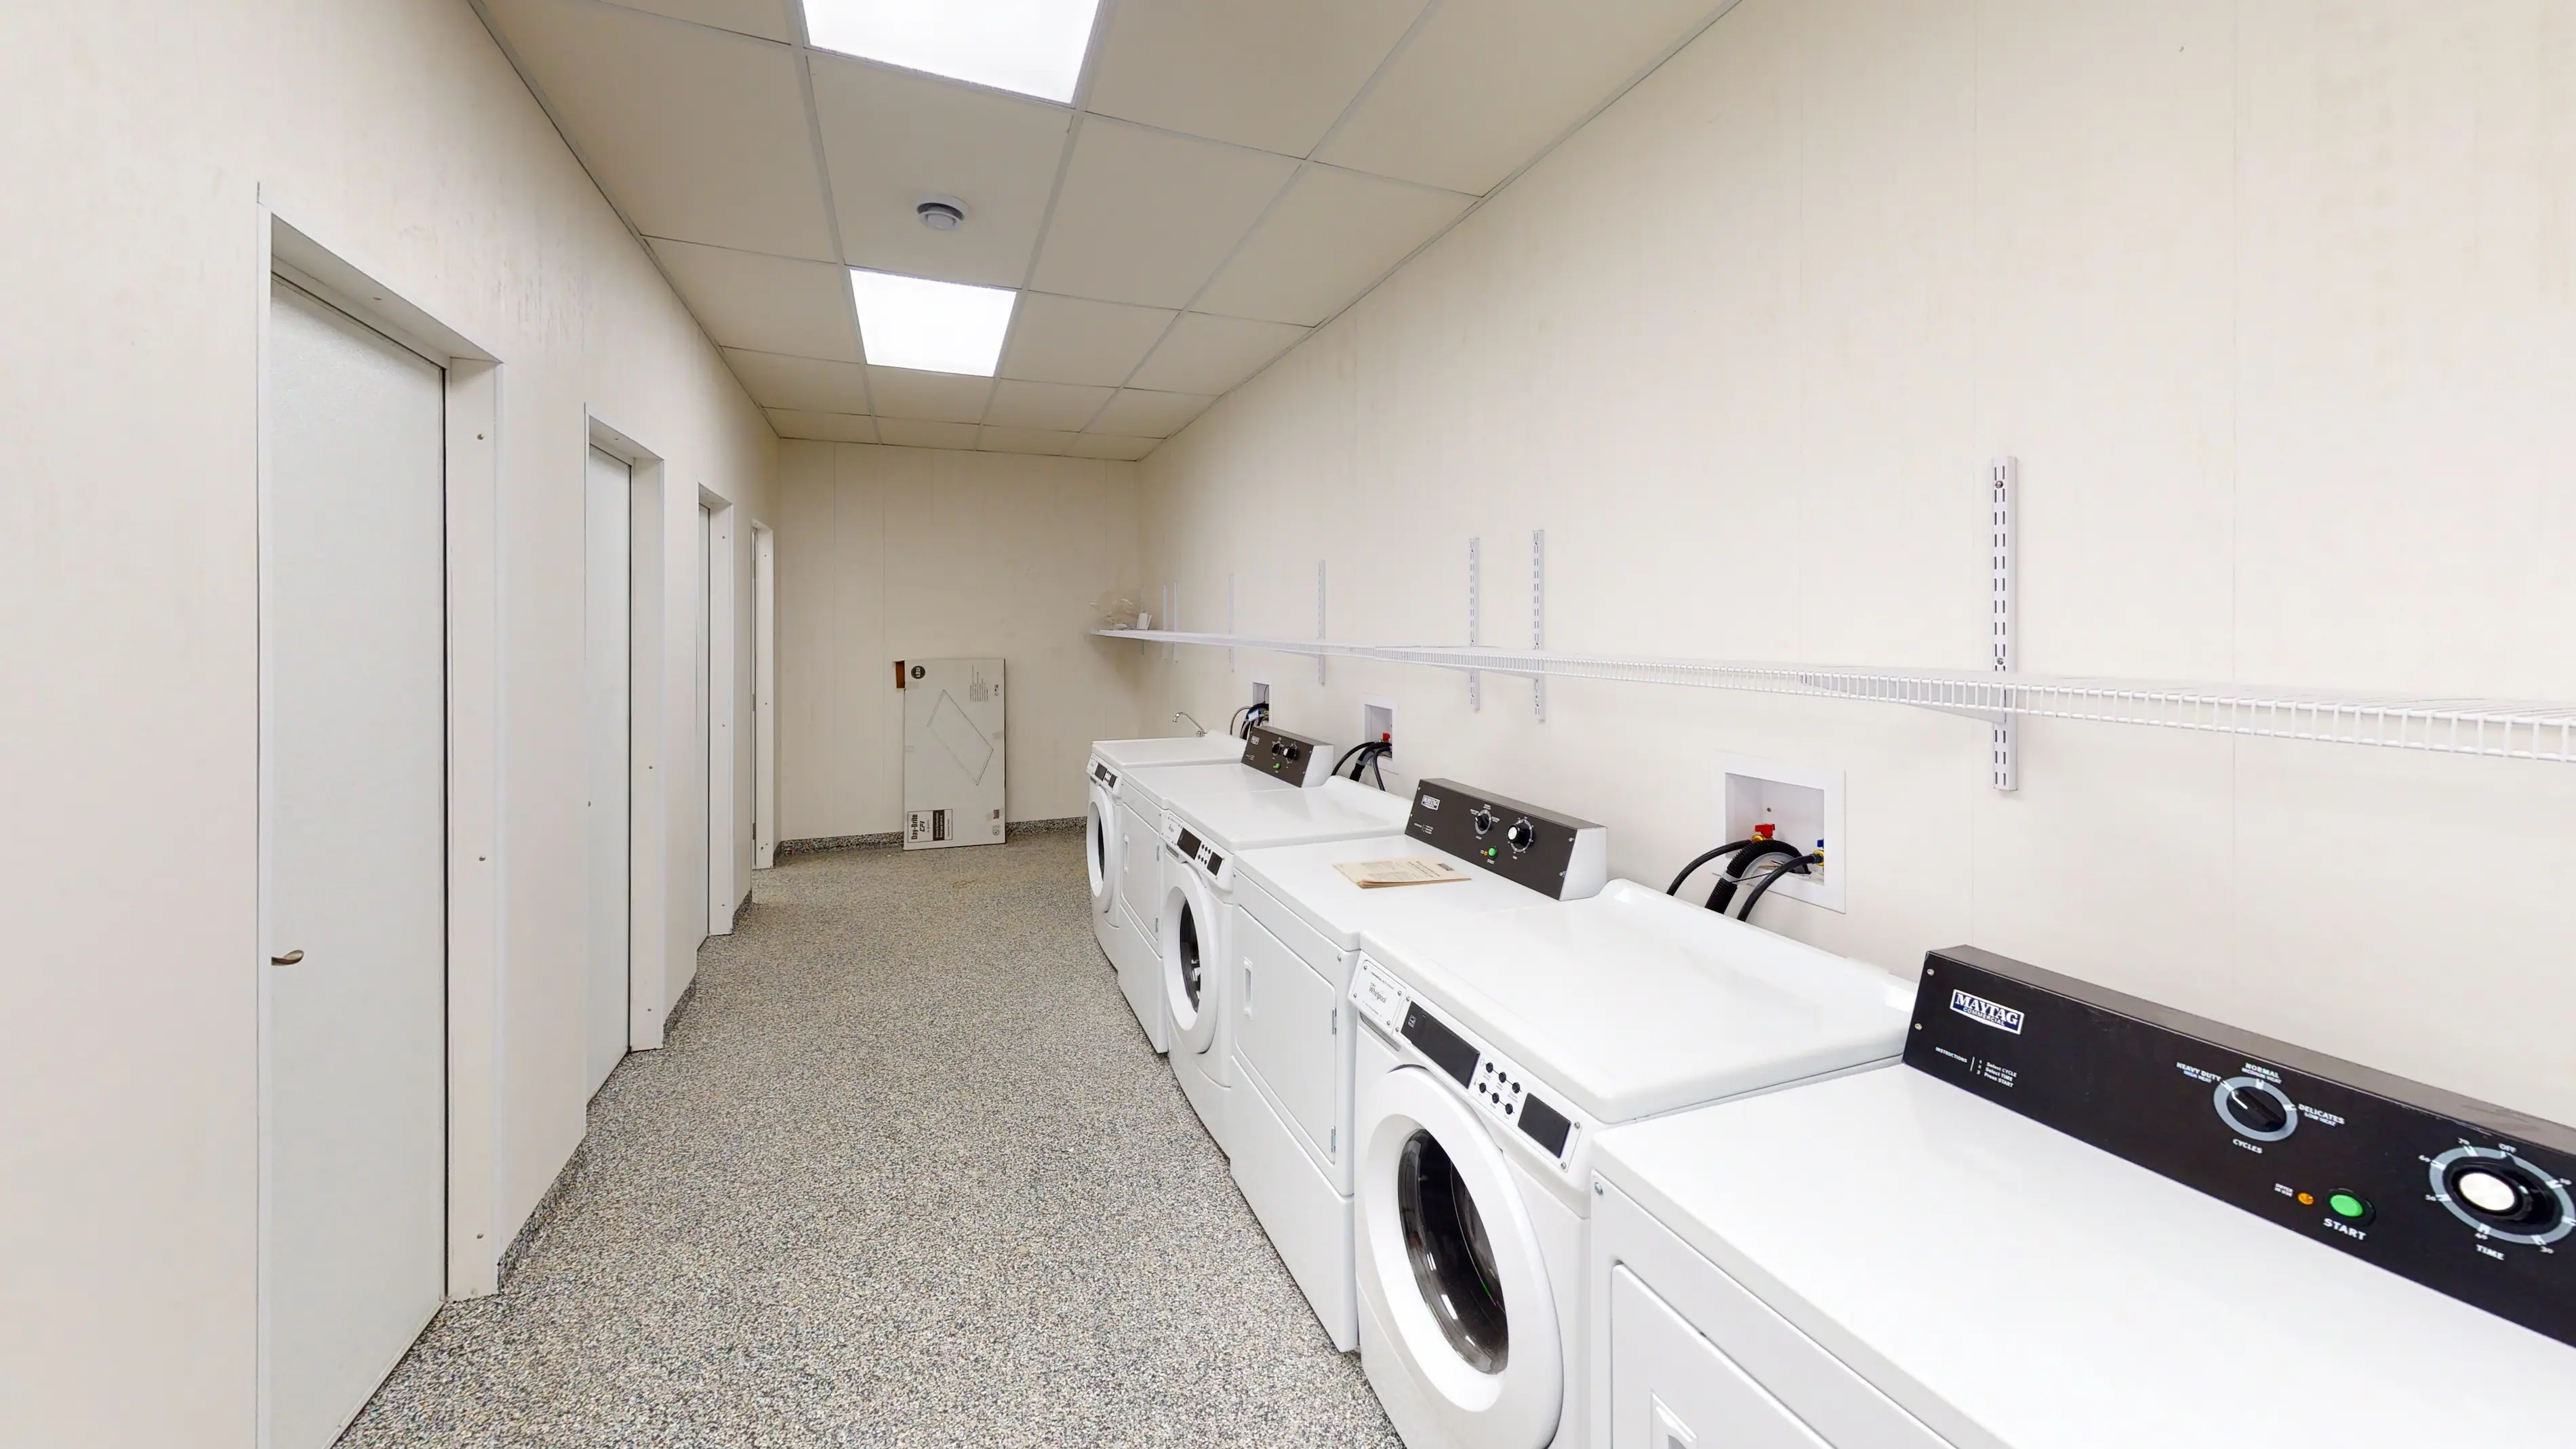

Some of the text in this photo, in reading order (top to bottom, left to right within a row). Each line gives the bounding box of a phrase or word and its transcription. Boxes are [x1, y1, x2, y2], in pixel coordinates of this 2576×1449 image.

[1369, 985, 1387, 1004] Whirlpool
[1955, 993, 2018, 1025] MAYTAG
[1963, 1006, 2005, 1026] COMMERCIAL
[1935, 1046, 1968, 1063] INSTRUCTIONS
[1985, 1067, 2000, 1076] Select
[2001, 1073, 2013, 1082] TIME
[1986, 1061, 2001, 1072] Select
[2002, 1068, 2017, 1078] CYCLE
[2176, 1062, 2222, 1082] HEAVY DUTY
[2245, 1062, 2280, 1079] NORMAL
[1984, 1072, 1998, 1082] Press
[1998, 1078, 2014, 1088] START
[2298, 1103, 2346, 1125] DELICATES
[2303, 1111, 2337, 1127] LOW HEAT
[2232, 1139, 2263, 1154] CYCLES
[2498, 1143, 2517, 1154] OFF
[2322, 1218, 2367, 1240] START
[2476, 1244, 2505, 1261] TIME
